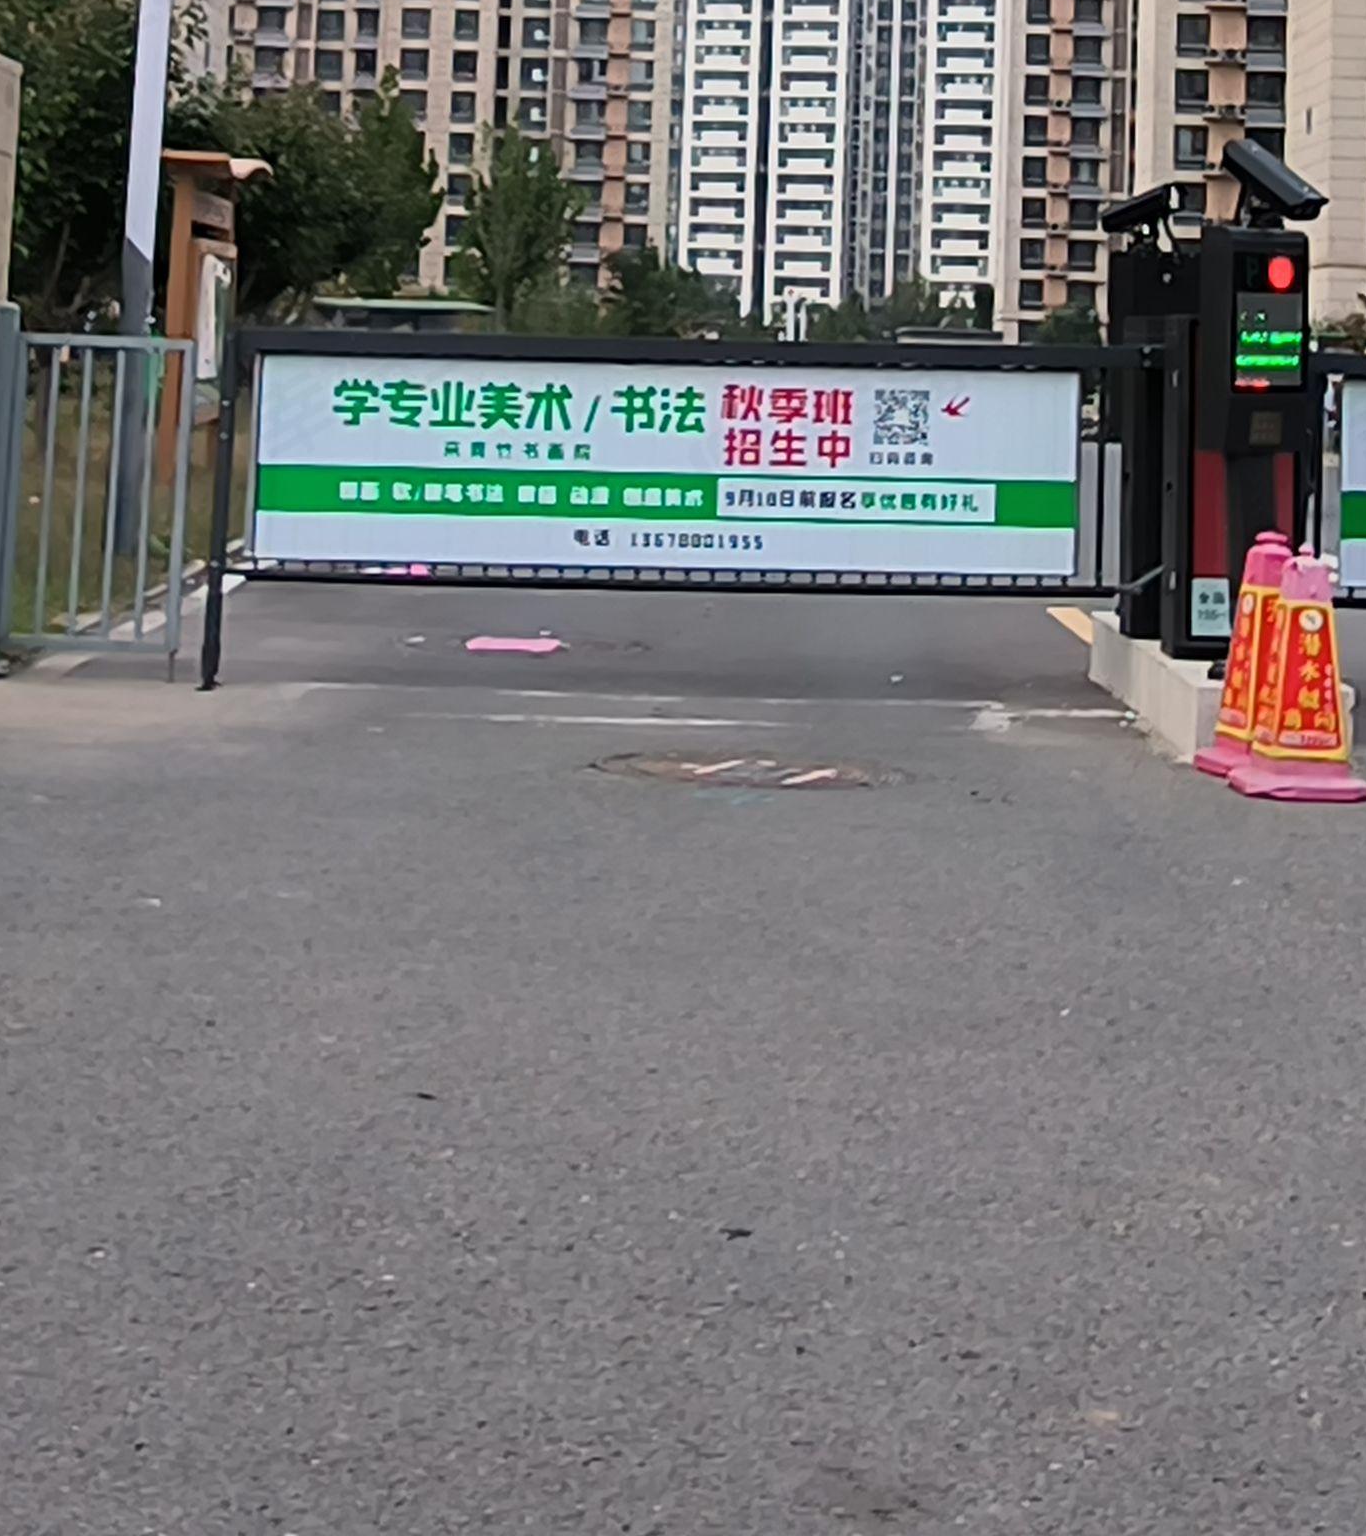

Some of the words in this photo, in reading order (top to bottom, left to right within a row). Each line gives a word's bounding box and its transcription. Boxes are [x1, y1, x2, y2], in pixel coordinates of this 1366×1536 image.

[720, 383, 854, 425] 秋季班
[723, 428, 851, 468] 招生中
[573, 528, 610, 547] 电话
